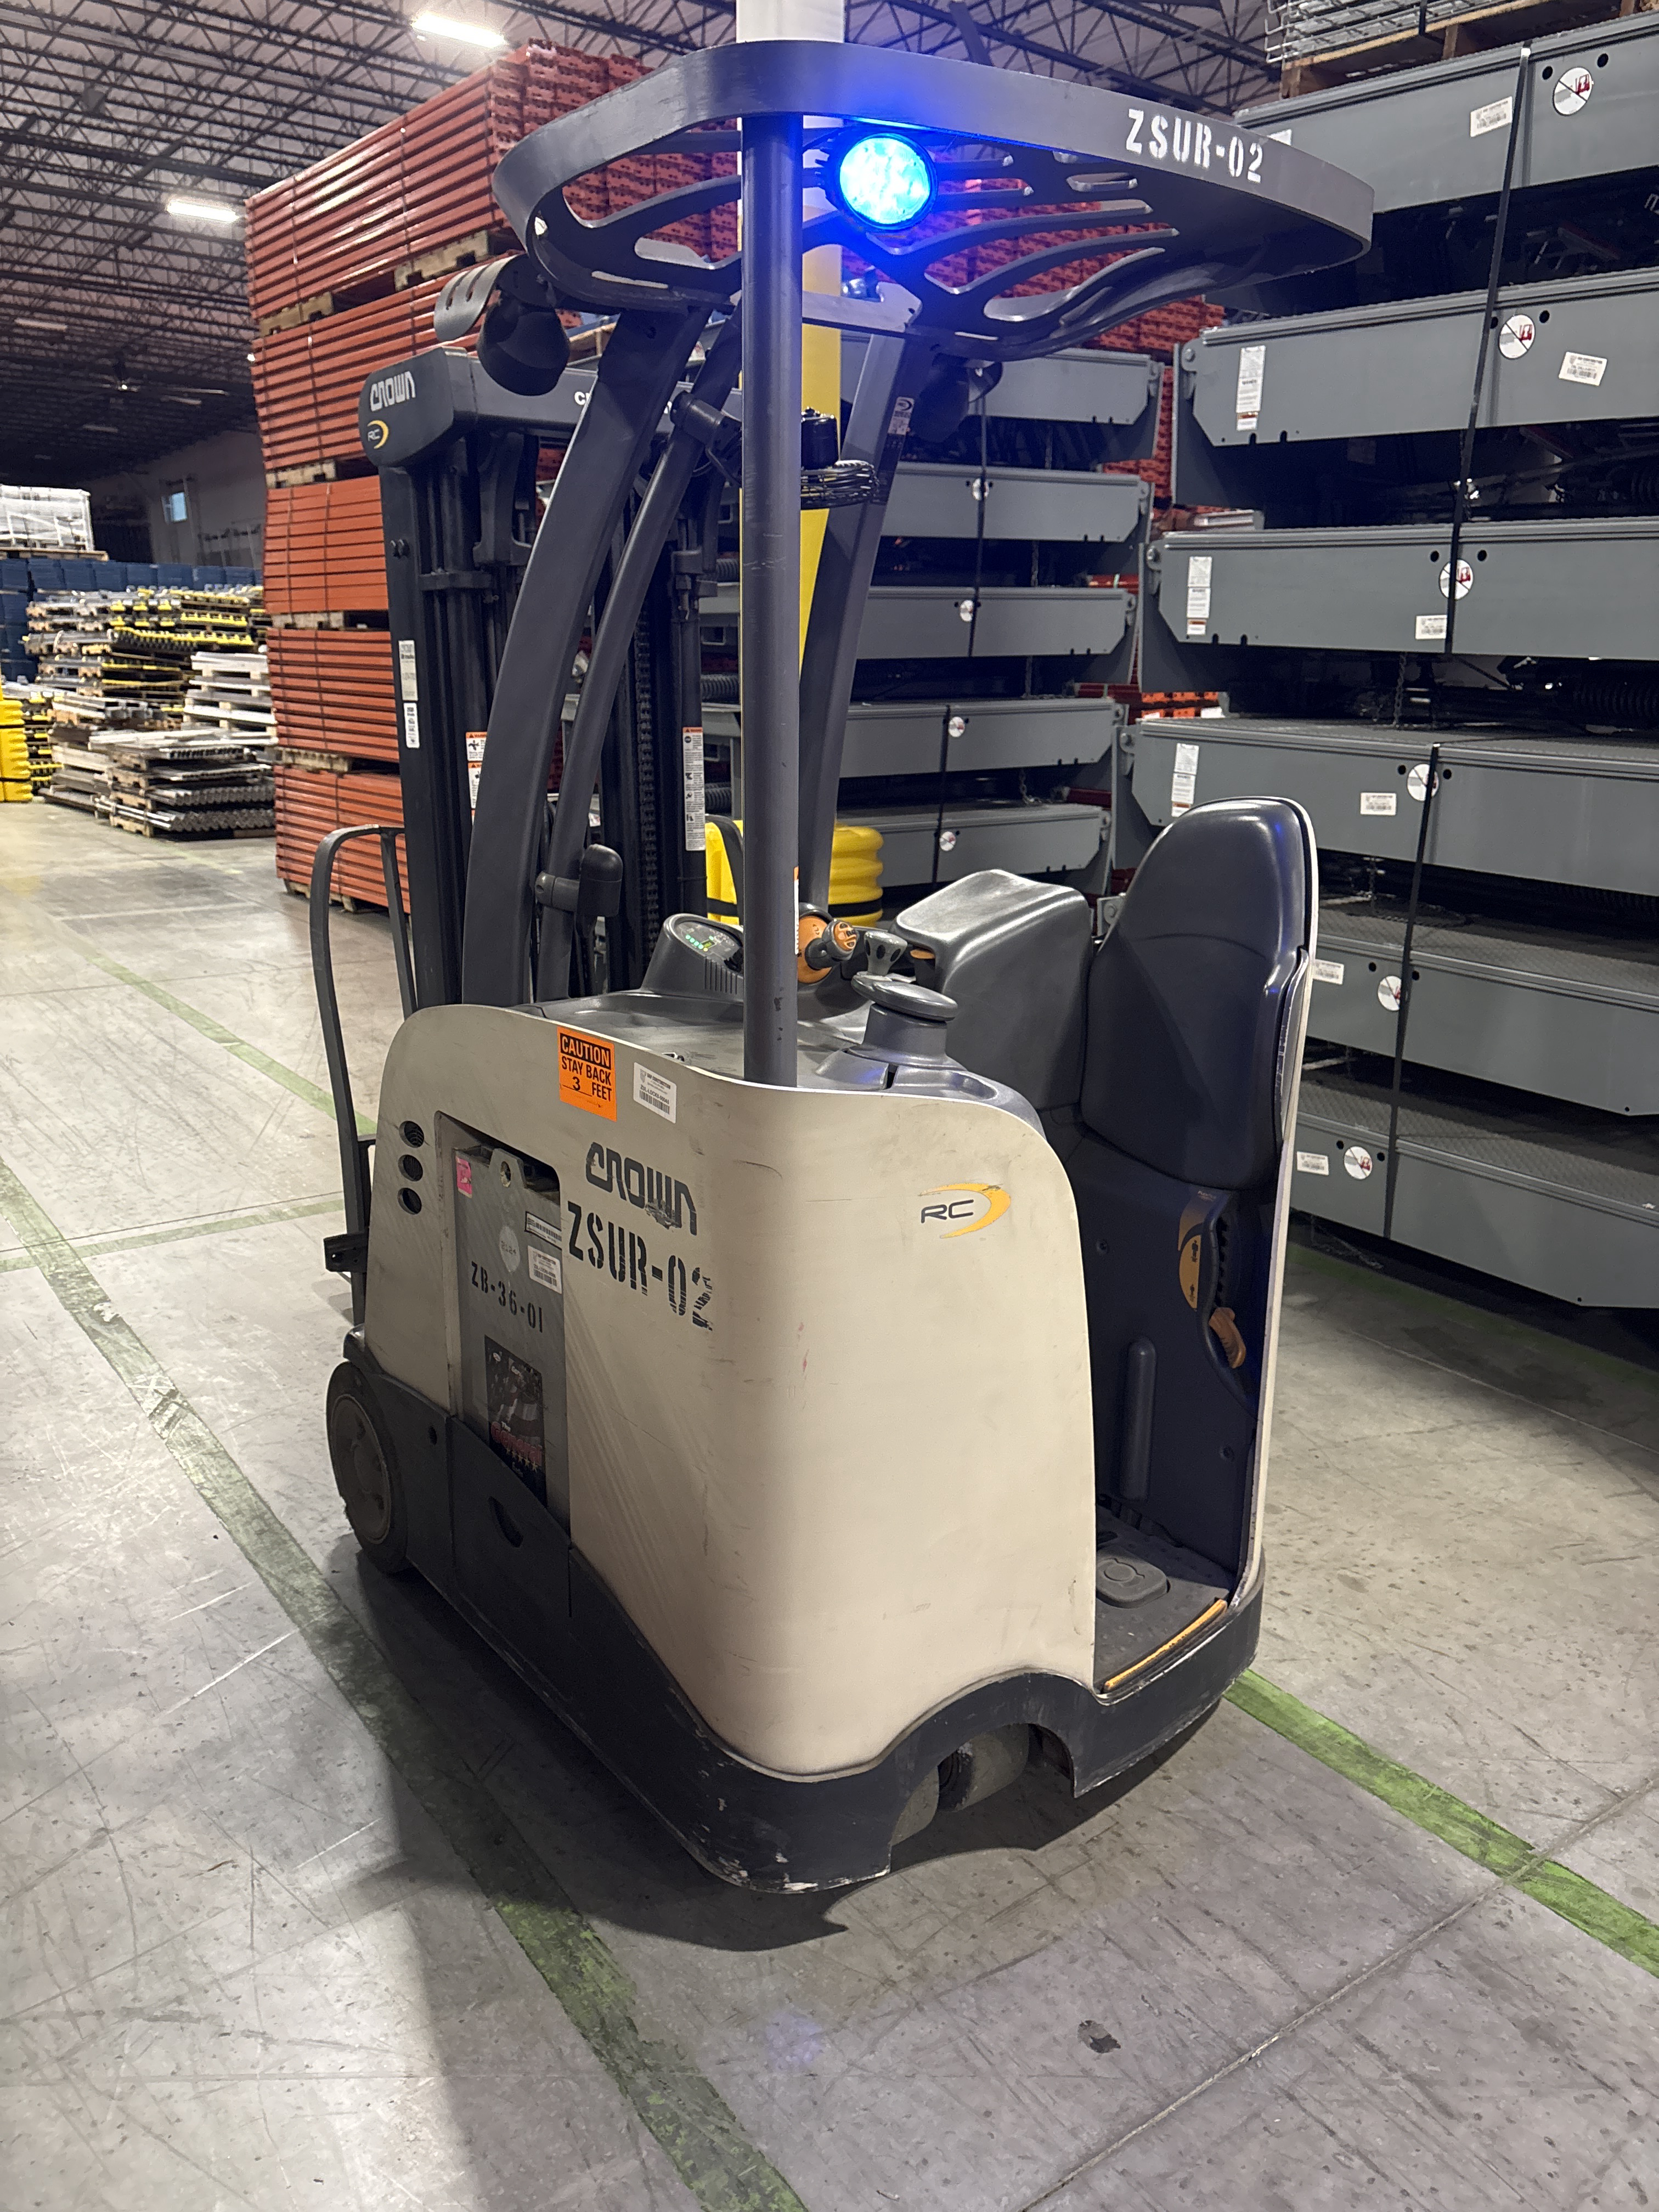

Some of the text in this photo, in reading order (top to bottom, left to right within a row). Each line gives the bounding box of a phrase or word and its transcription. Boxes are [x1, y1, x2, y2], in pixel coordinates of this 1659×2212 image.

[1126, 108, 1263, 184] ZSUR-02
[367, 428, 381, 442] RC
[561, 1035, 610, 1068] CAUTION
[561, 1056, 611, 1086] STAY BACK
[572, 1076, 612, 1102] 3 FEET
[921, 1199, 974, 1224] RC
[567, 1200, 713, 1331] ZSUR-02
[471, 1260, 543, 1334] ZB-36-01
[501, 1421, 511, 1432] The
[490, 1421, 543, 1467] General
